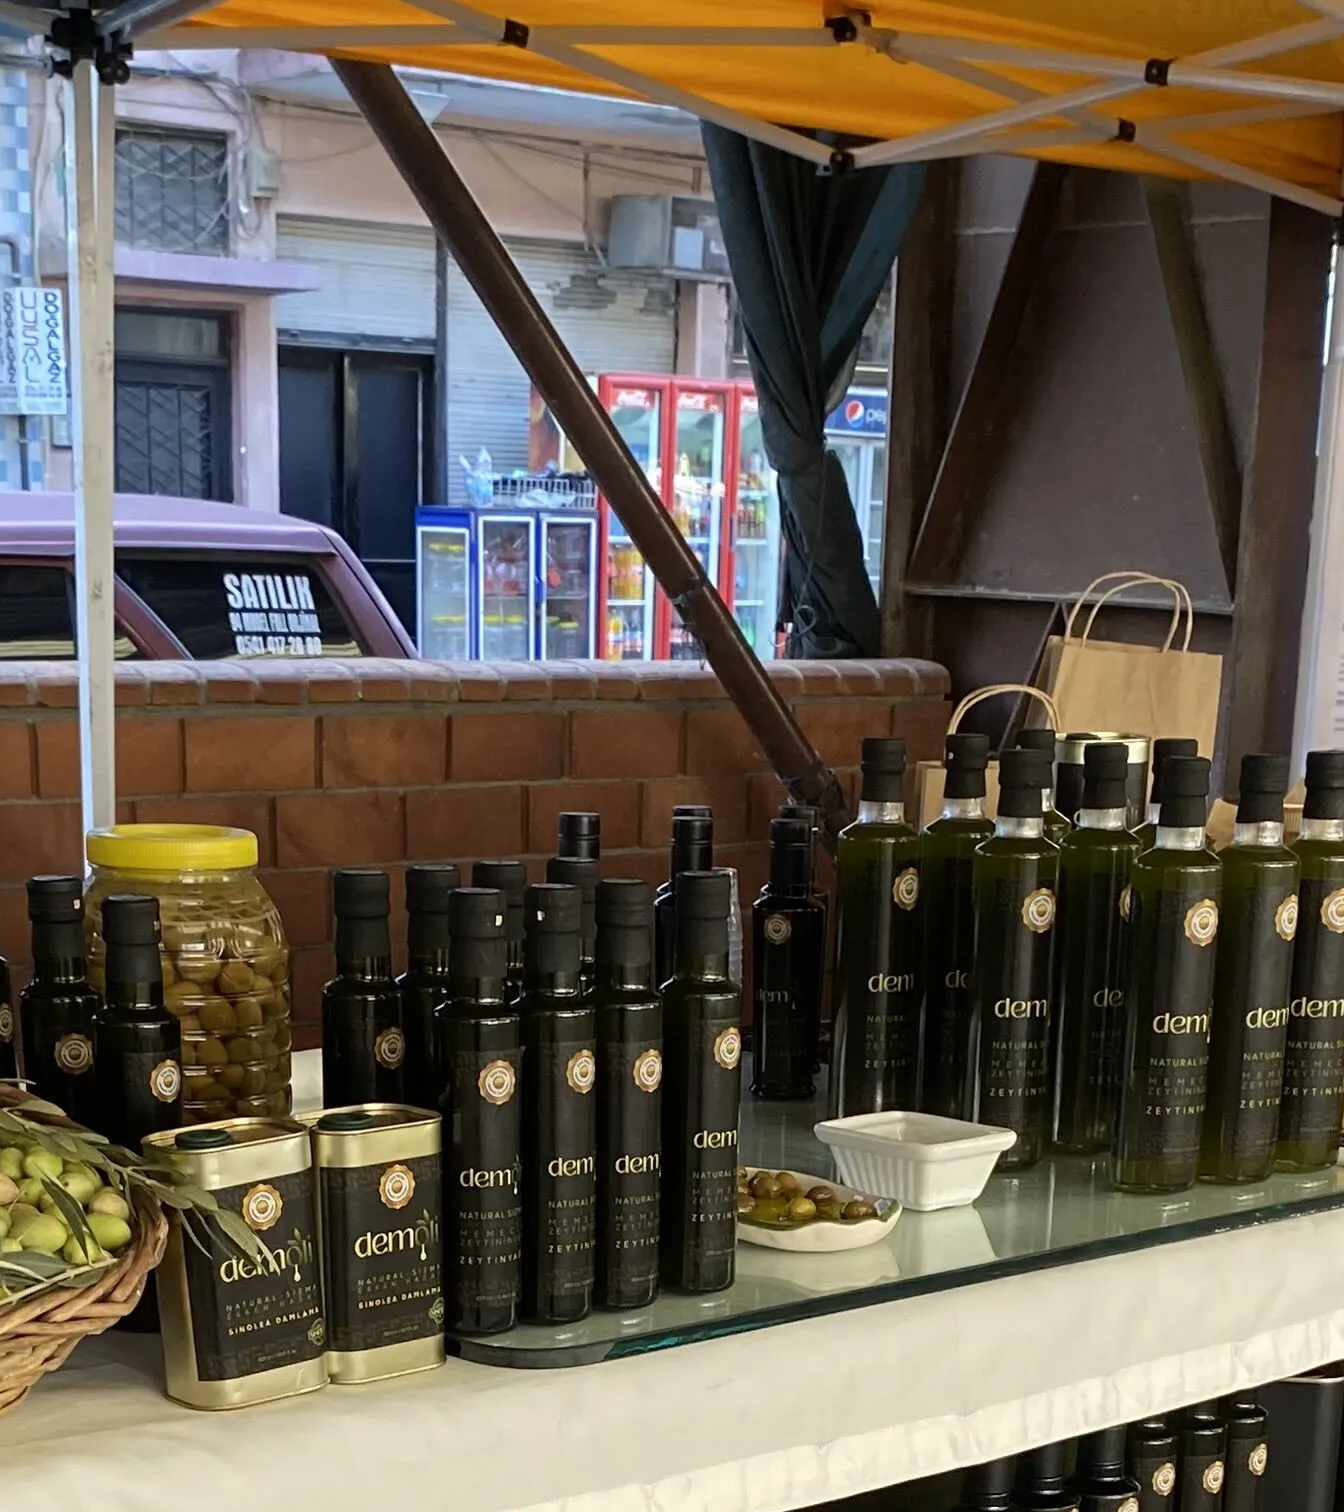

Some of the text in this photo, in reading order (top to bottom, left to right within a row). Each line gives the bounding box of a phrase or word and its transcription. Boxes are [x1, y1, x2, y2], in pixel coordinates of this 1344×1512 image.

[223, 573, 316, 610] SATILIK
[994, 997, 1047, 1020] dem
[1152, 1012, 1208, 1035] dem
[548, 1156, 594, 1177] dem
[615, 1153, 659, 1175] dem
[354, 1214, 439, 1258] demoli
[358, 1295, 397, 1310] SINOLEA
[228, 1306, 320, 1336] SINOLEA DAMLAMA
